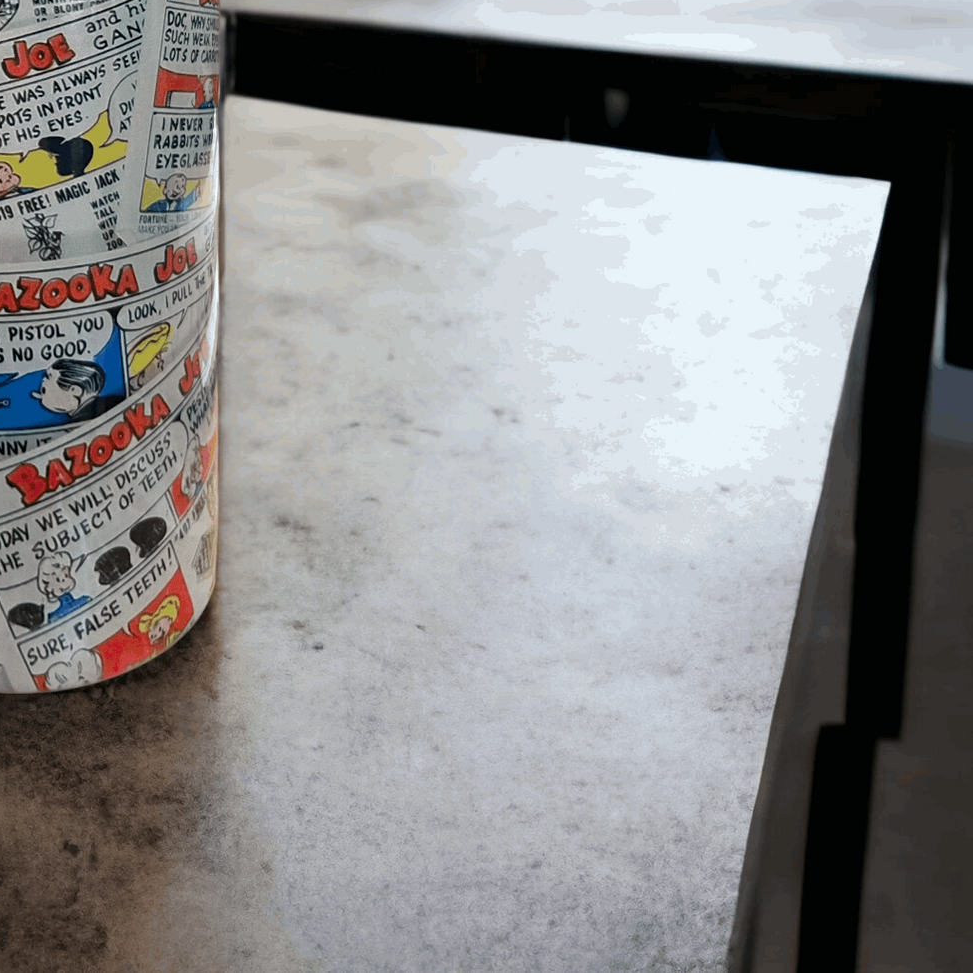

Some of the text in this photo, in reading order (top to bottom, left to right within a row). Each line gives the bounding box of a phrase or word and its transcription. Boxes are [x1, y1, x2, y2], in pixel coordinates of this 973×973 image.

[34, 7, 47, 17] OR
[85, 10, 122, 34] and
[164, 28, 190, 45] SUCH
[1, 32, 76, 79] JOE
[163, 46, 199, 64] LOTS OF
[12, 83, 45, 105] WAS
[52, 63, 106, 94] ALWAYS
[37, 102, 55, 118] IN
[56, 82, 103, 111] FRONT
[16, 126, 41, 146] HIS
[161, 117, 203, 132] I NEVER
[153, 133, 200, 150] RABBITS
[18, 168, 120, 215] FREE! MAGIC JACK
[89, 191, 120, 209] WATCH
[94, 206, 115, 220] TALL
[139, 214, 168, 224] FORTUNE
[102, 229, 115, 241] UP
[154, 236, 198, 284] JOE
[128, 301, 161, 324] LOOK,
[172, 286, 192, 306] PULL
[9, 324, 66, 342] PISTOL
[73, 316, 105, 334] YOU
[12, 346, 33, 362] NO
[41, 338, 91, 360] GOOD.
[5, 393, 171, 507] BAZOOKA
[35, 508, 68, 531] WE
[69, 484, 114, 517] WILL
[115, 431, 171, 489] DISCUSS
[32, 504, 112, 560] SUBJECT
[119, 488, 136, 510] OF
[26, 633, 74, 666] SURE,
[74, 599, 122, 640] FALSE
[122, 547, 174, 605] TEETH!
